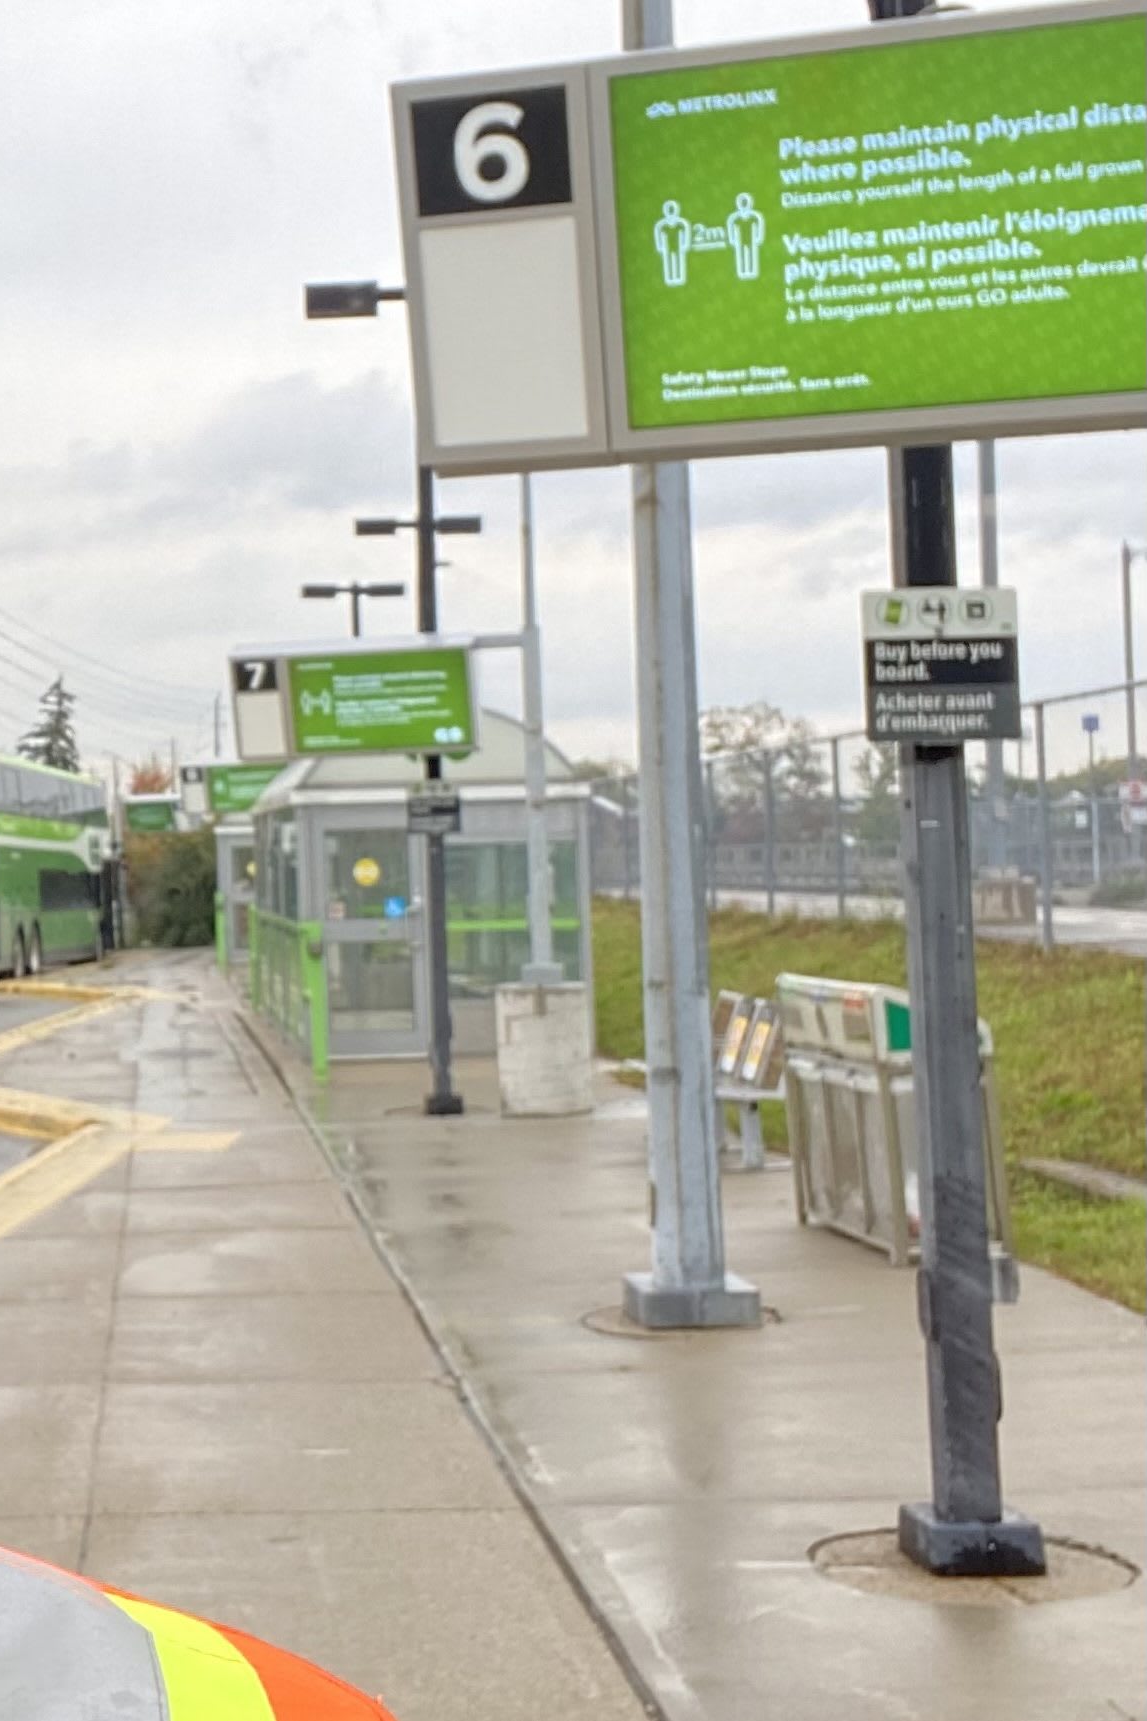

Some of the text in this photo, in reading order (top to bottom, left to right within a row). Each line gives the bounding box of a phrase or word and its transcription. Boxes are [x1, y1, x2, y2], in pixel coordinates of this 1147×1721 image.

[678, 88, 777, 113] METROLINX
[779, 136, 857, 160] Please
[862, 119, 971, 150] maintain
[975, 105, 1078, 145] physical
[454, 101, 530, 202] 6
[780, 146, 972, 185] where possible.
[781, 159, 1143, 208] Distance yourself the length of a full grown
[692, 223, 725, 241] 2m
[782, 227, 877, 256] Veuillez
[883, 213, 999, 246] maintenir
[784, 237, 1042, 285] physique, si possible.
[785, 288, 804, 304] La
[808, 282, 877, 301] distance
[881, 278, 924, 296] entre
[928, 274, 968, 291] vous
[971, 271, 988, 287] et
[991, 267, 1016, 284] les
[1020, 264, 1073, 282] autres
[1077, 256, 1137, 277] devrait
[786, 284, 1070, 324] à la longueur d'un ours GO adulte.
[662, 372, 704, 386] Safety
[706, 369, 747, 382] Never
[663, 385, 738, 401] Destination
[875, 639, 1003, 664] Buy before you
[244, 661, 266, 690] 7
[875, 660, 930, 682] board.
[876, 691, 995, 711] Acheter avant
[876, 712, 990, 734] d'embarquer.
